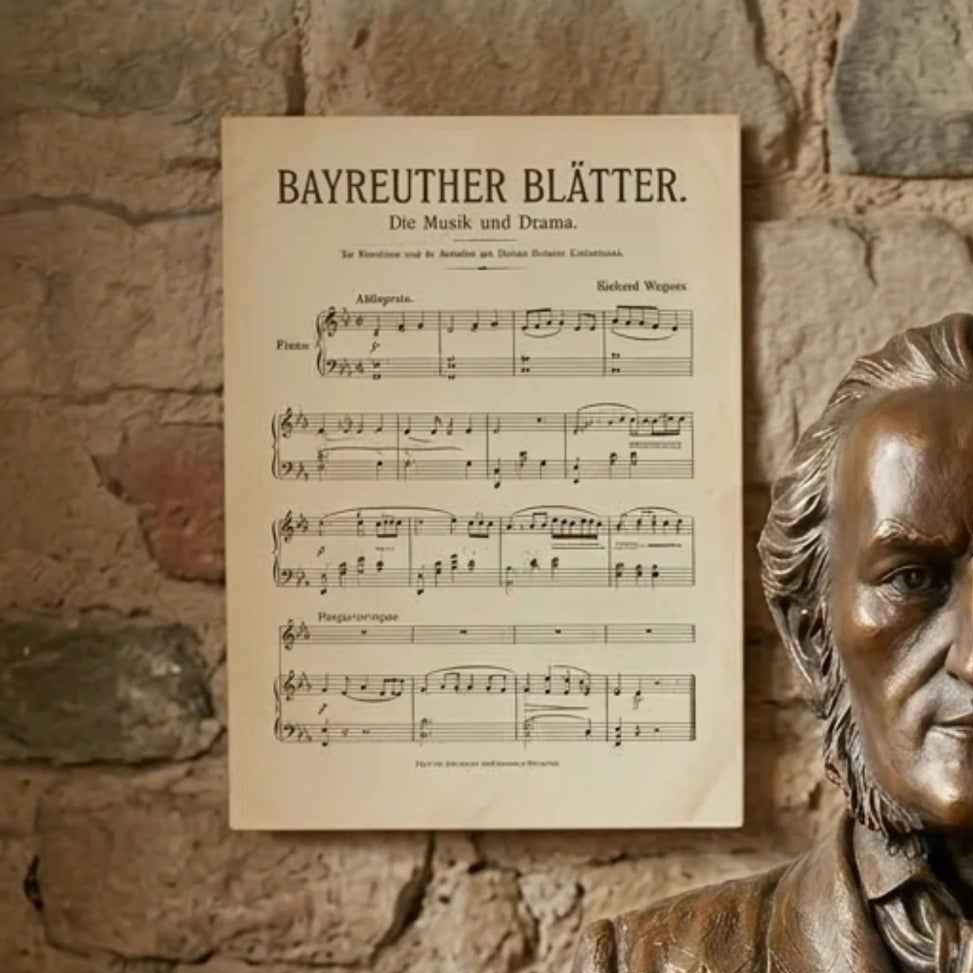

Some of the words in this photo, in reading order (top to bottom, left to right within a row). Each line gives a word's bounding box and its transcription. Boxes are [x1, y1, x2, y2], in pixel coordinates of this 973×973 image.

[277, 168, 507, 204] BAYREUTHER
[523, 160, 688, 203] BLÄTTER.
[423, 214, 472, 230] Musik
[480, 214, 511, 230] und
[519, 214, 577, 230] Drama.
